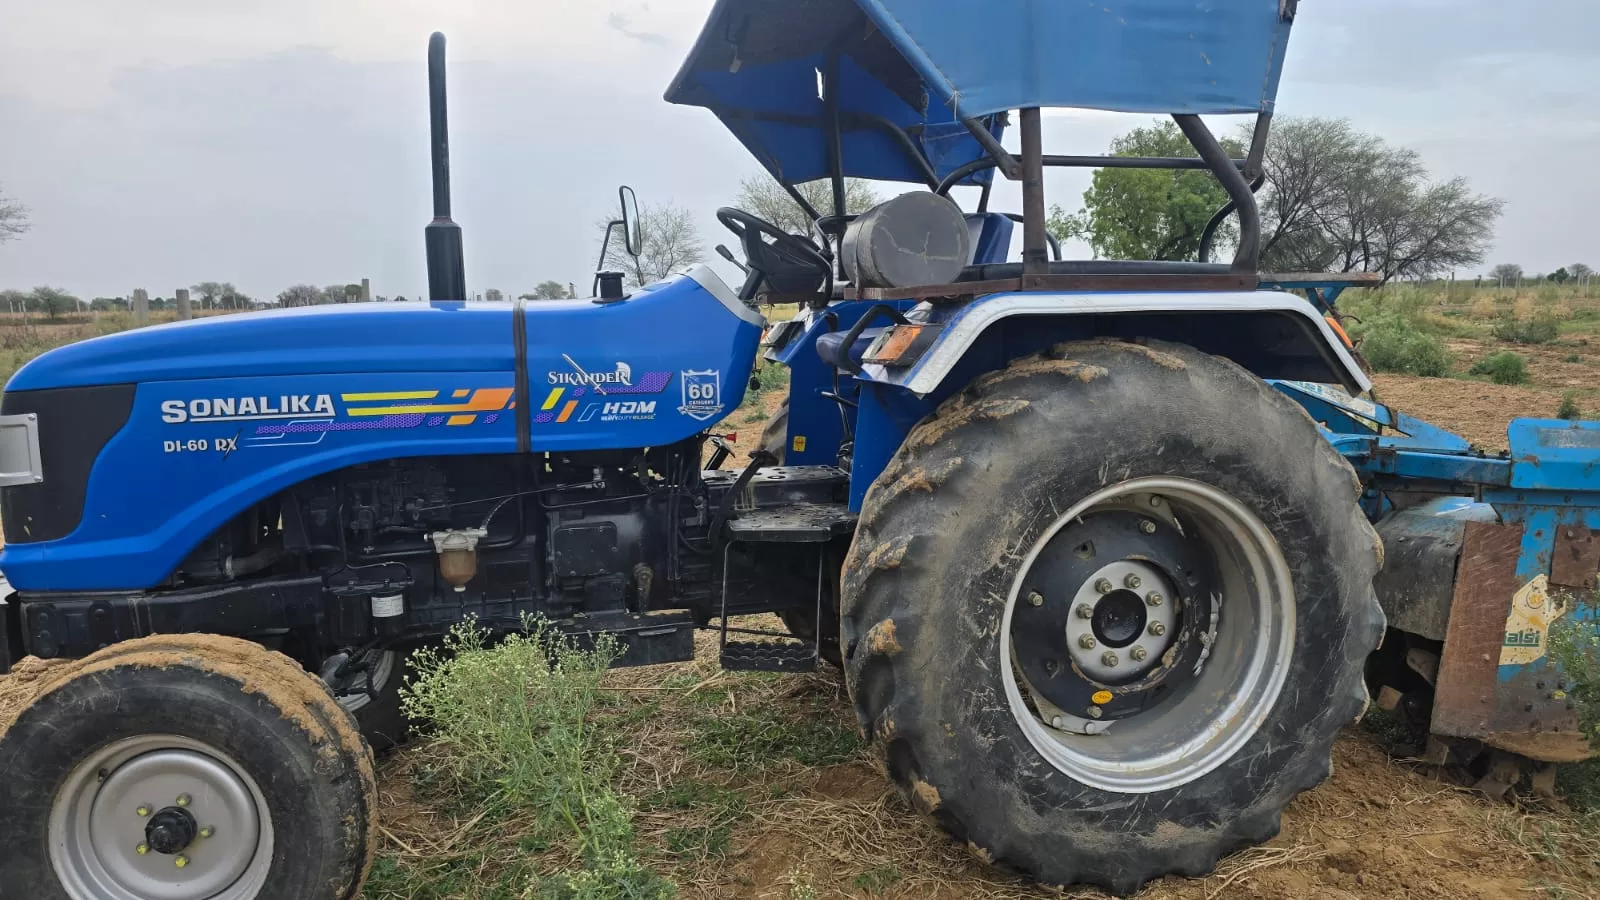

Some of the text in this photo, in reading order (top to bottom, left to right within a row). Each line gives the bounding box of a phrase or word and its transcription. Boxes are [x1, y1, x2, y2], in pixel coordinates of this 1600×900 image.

[547, 365, 633, 386] SIKANDER
[688, 383, 714, 400] 60
[161, 394, 336, 423] SONALIKA
[602, 400, 657, 415] HDM
[163, 437, 237, 453] DI-60 RX
[1504, 630, 1540, 644] alsi
